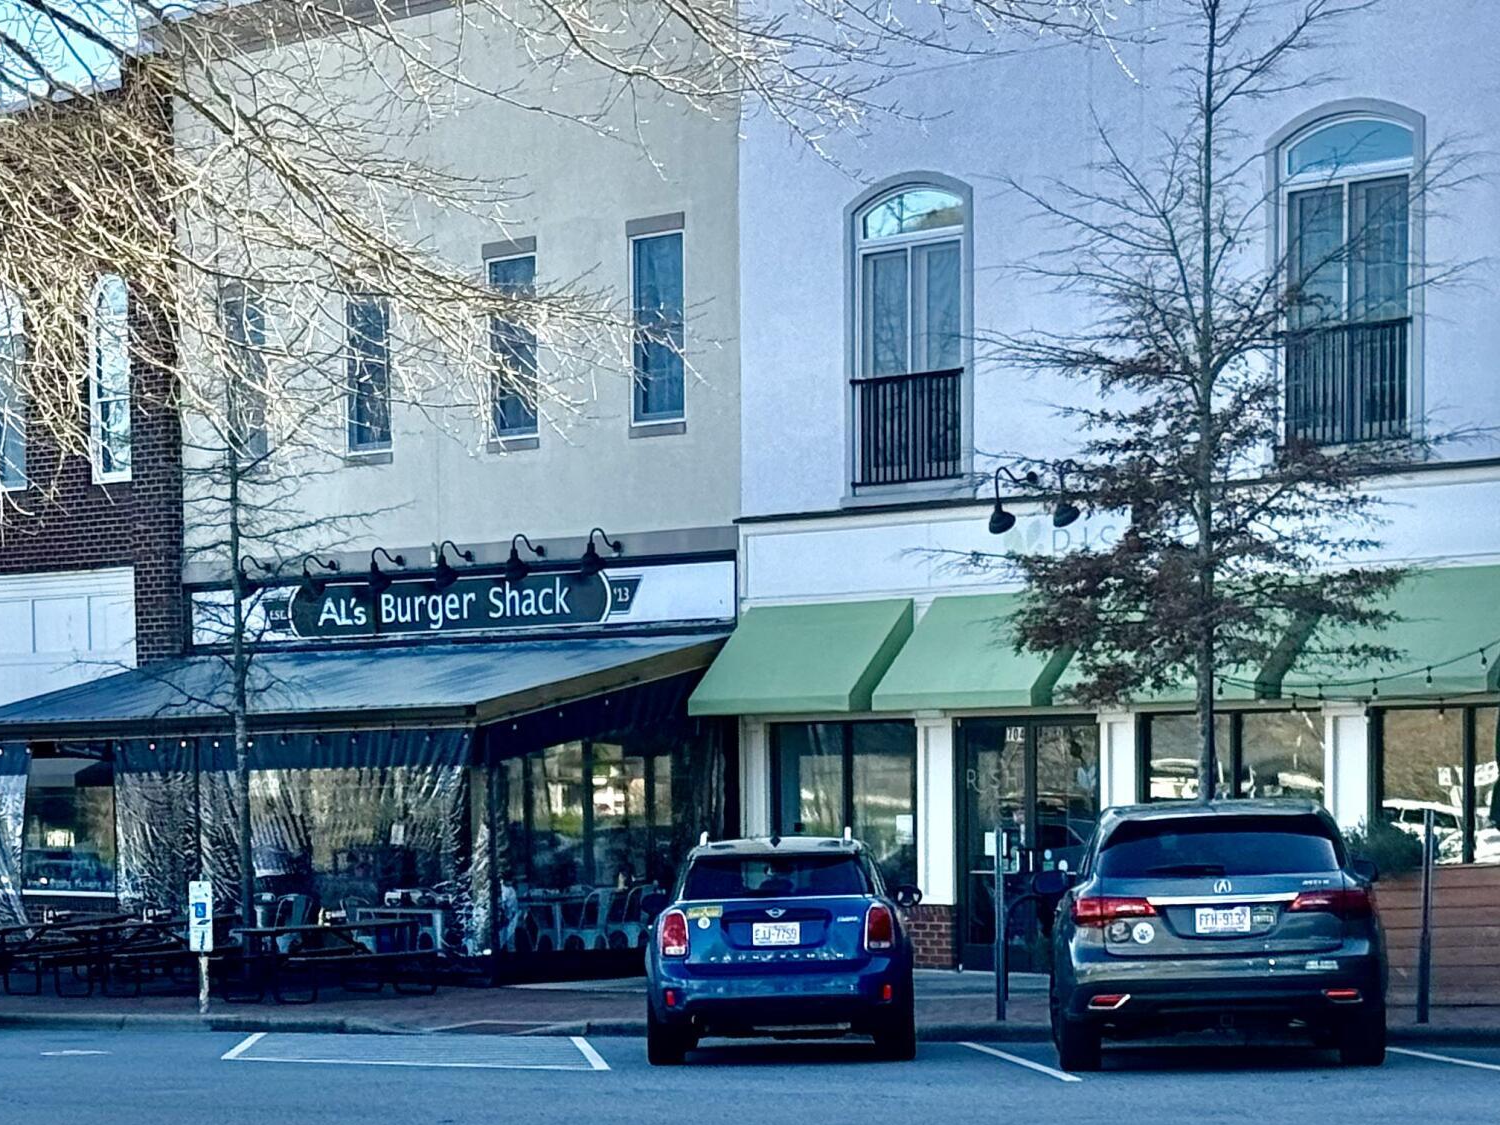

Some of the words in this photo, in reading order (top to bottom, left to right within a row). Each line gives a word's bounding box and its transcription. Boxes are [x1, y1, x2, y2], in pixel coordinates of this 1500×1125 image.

[318, 597, 367, 627] AL's
[381, 592, 476, 630] Burger
[488, 576, 571, 619] Shack
